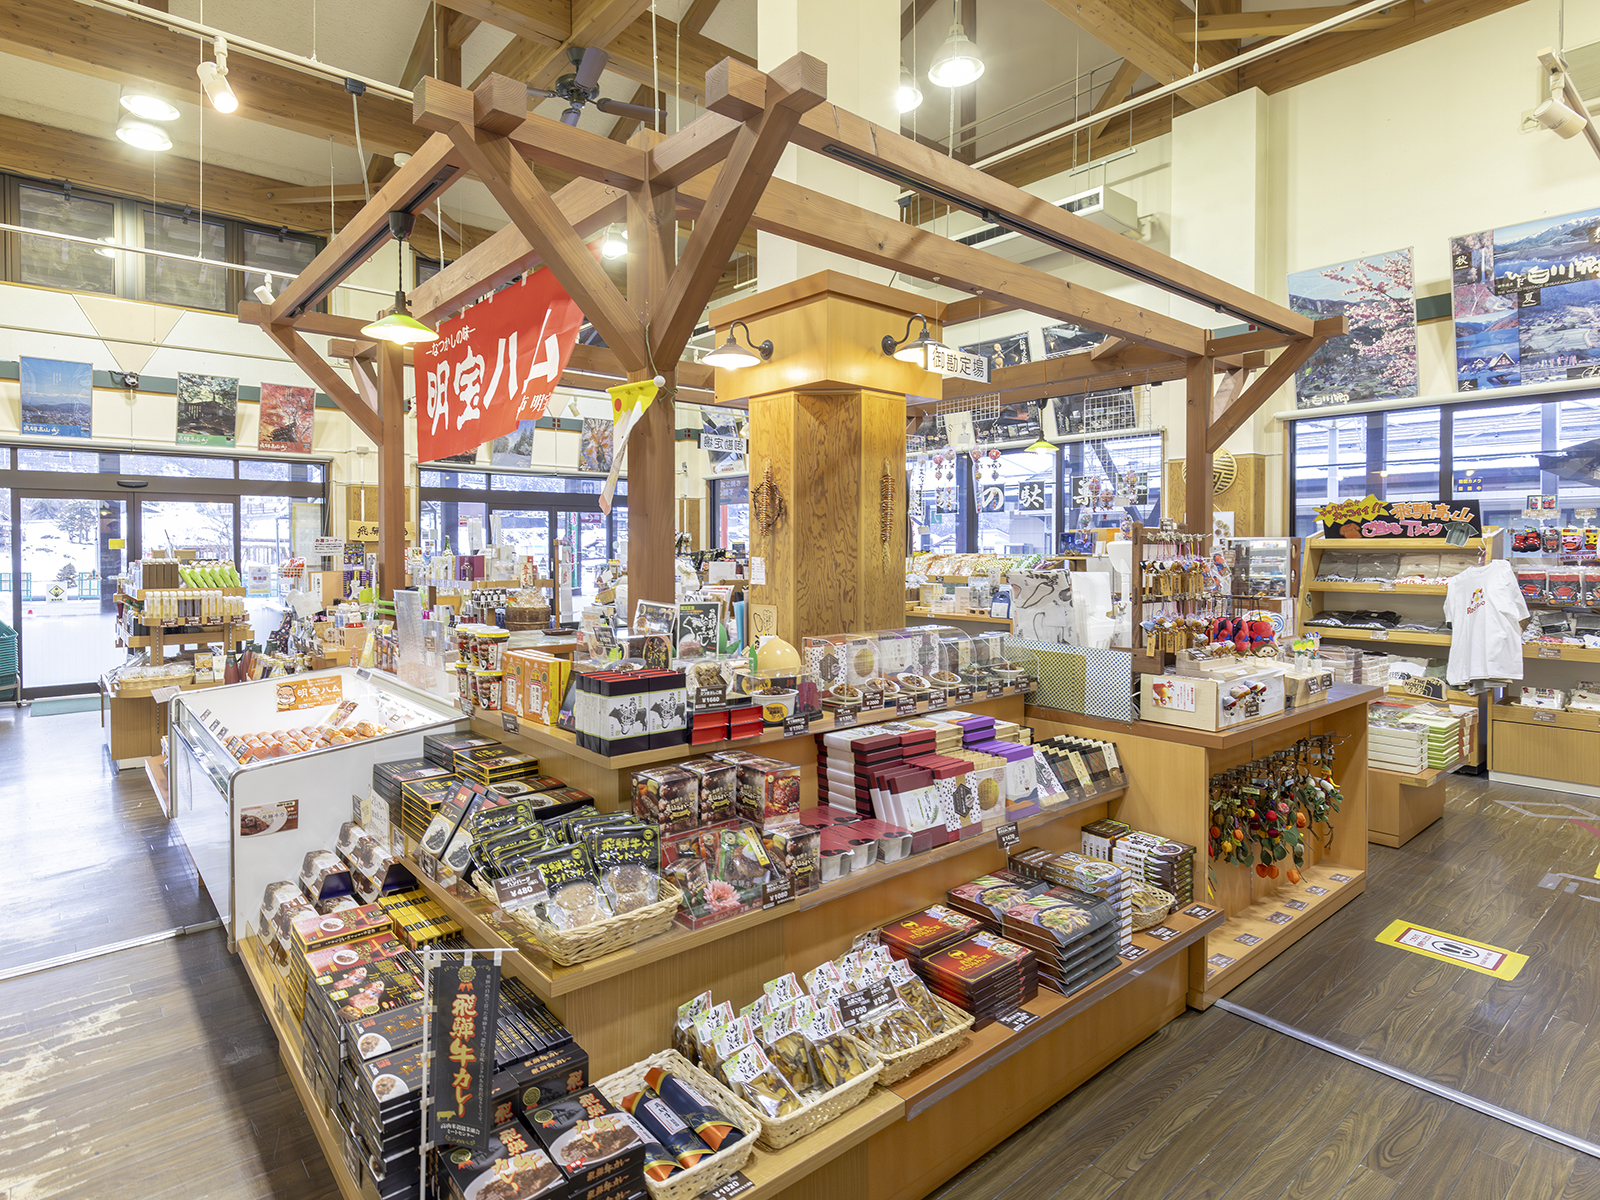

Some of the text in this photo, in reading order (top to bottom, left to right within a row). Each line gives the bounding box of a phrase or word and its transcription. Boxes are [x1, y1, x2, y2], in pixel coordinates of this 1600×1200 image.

[1522, 283, 1543, 291] HERITAGE
[1523, 291, 1537, 303] 夏
[426, 308, 561, 436] 明宝ハム
[1460, 380, 1474, 391] 冬
[1389, 502, 1475, 522] 飛騨高山
[297, 685, 342, 698] 明宝ハム
[510, 885, 534, 898] ¥480
[872, 993, 890, 1006] ¥590
[849, 1005, 868, 1017] ¥590
[447, 993, 479, 1119] 飛騨牛カレー
